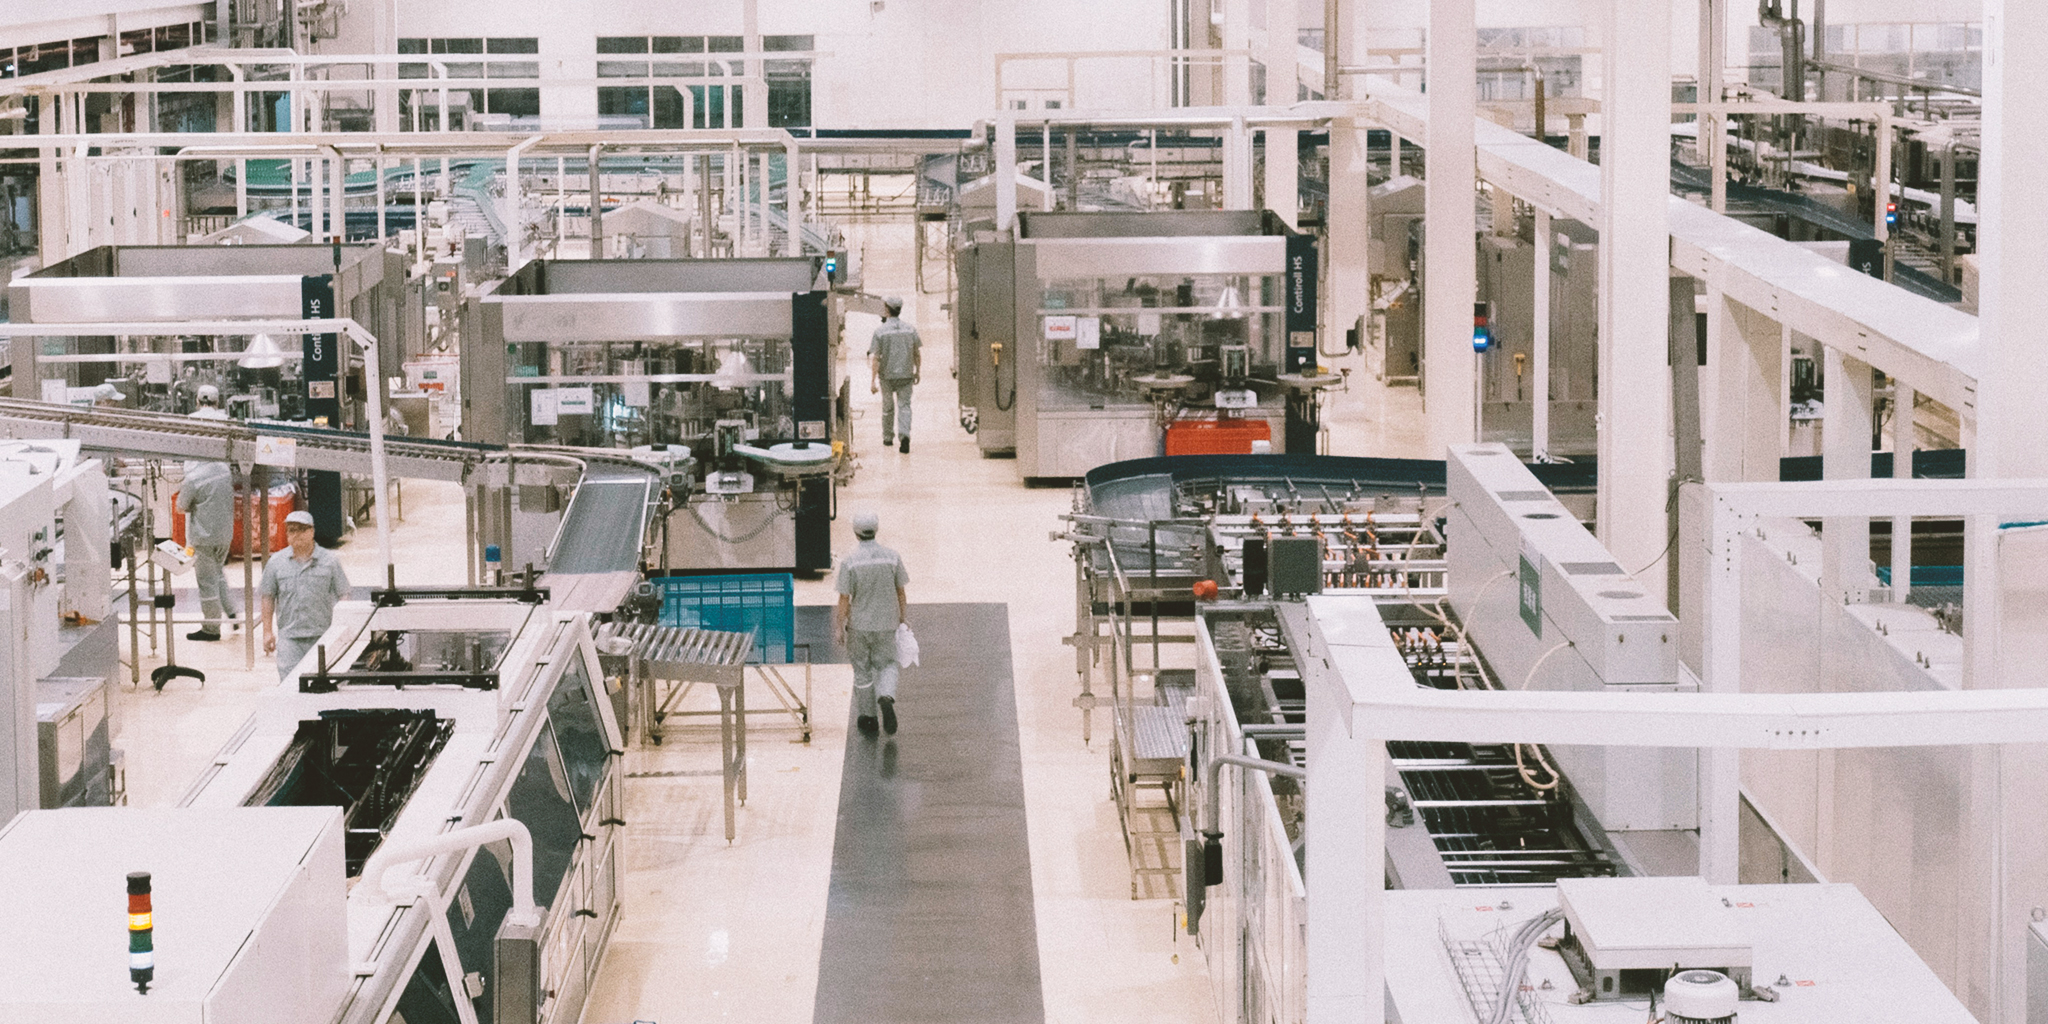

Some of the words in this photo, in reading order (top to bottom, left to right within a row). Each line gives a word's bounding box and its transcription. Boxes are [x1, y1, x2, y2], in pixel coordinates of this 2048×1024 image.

[1293, 255, 1303, 270] HS
[1293, 271, 1303, 314] Contiroll
[310, 299, 321, 314] HS
